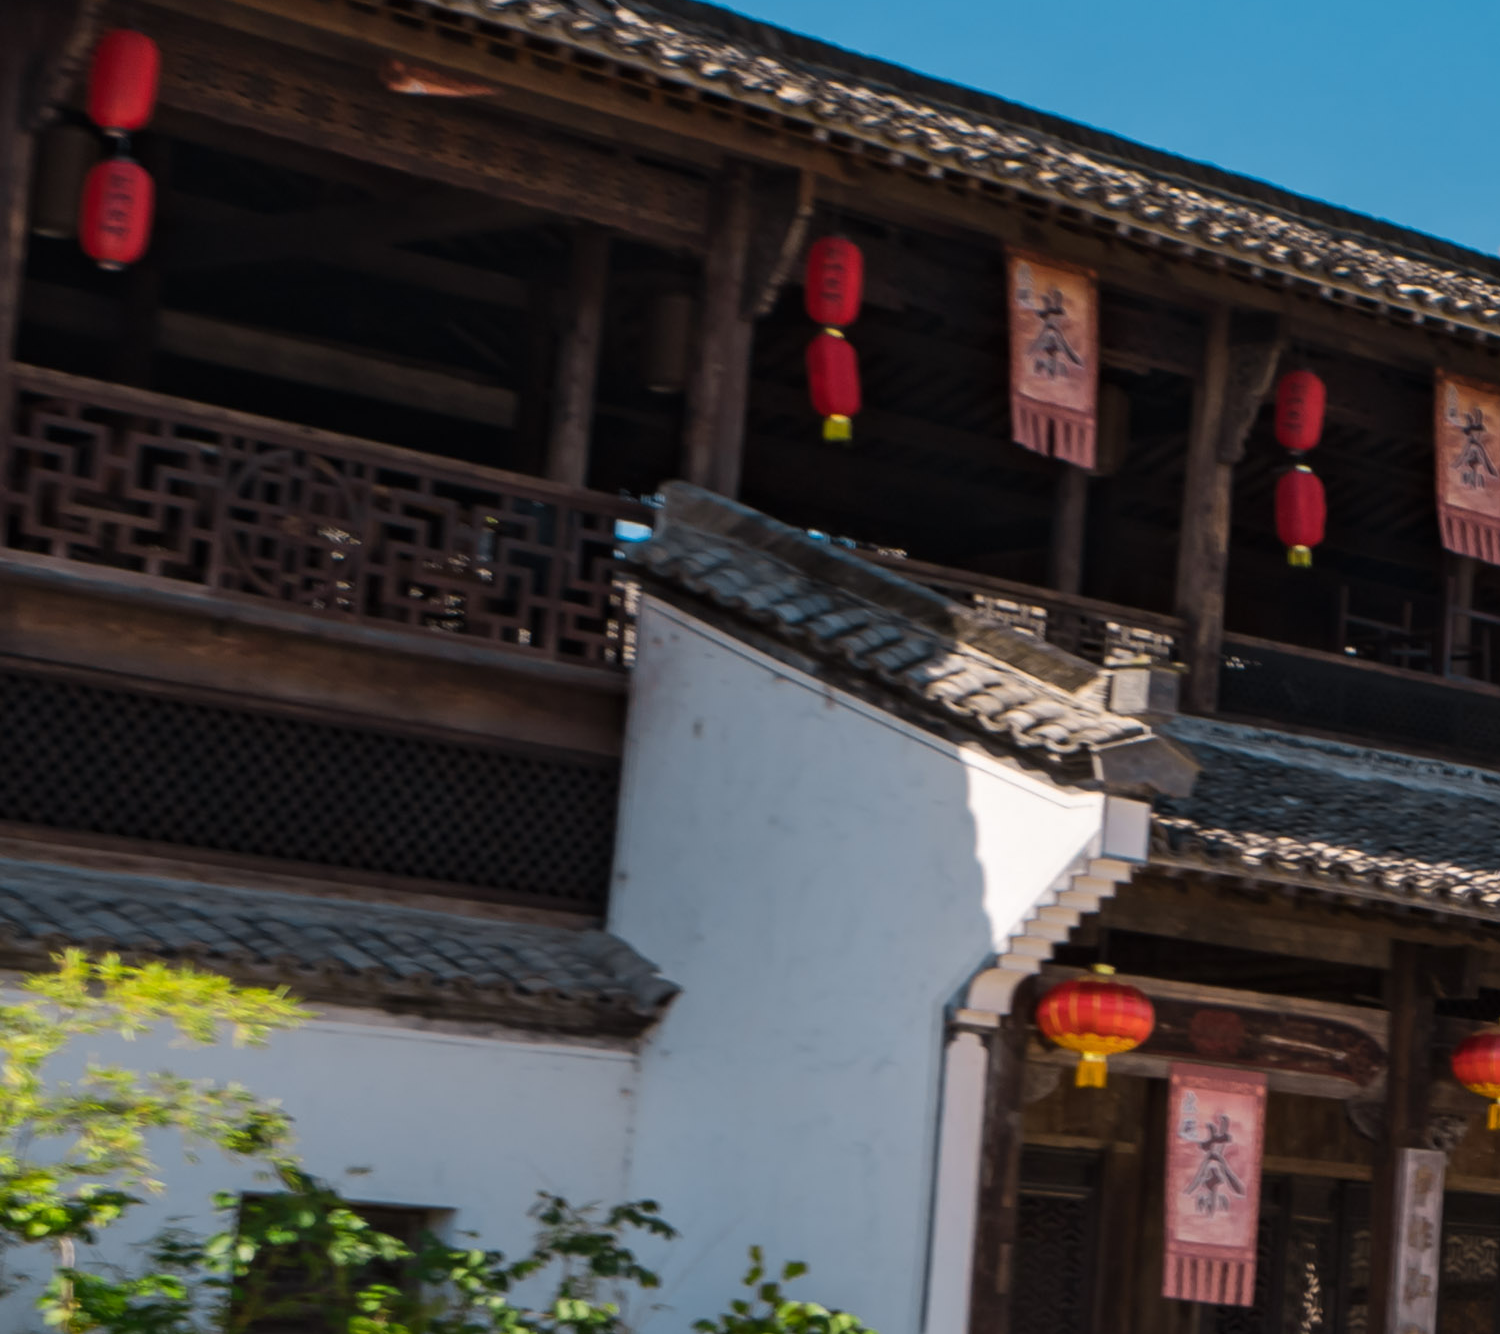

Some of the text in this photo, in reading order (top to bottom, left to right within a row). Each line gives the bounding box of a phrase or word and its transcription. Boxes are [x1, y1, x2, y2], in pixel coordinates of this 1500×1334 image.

[1026, 287, 1084, 380] 茶
[1449, 406, 1499, 490] 茶
[1183, 1113, 1246, 1218] 茶
